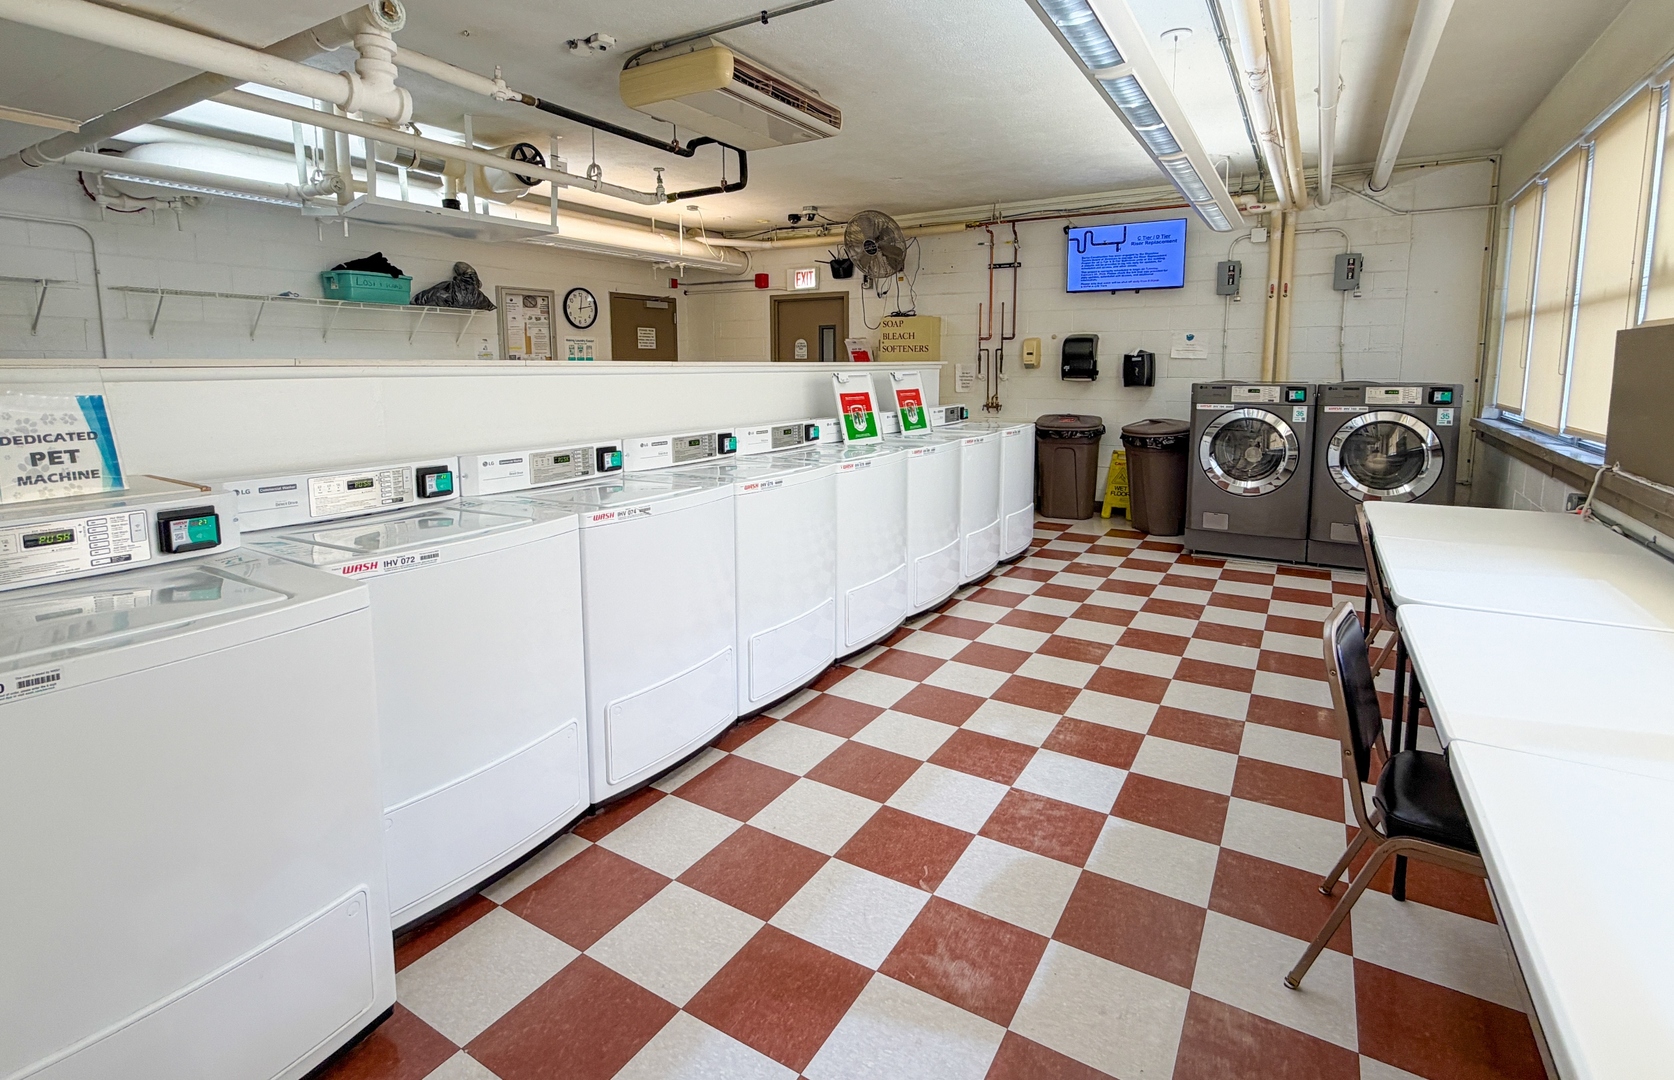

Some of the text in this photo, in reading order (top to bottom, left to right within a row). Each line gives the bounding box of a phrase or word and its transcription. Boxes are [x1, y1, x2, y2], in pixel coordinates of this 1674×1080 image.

[796, 271, 813, 286] EXIT
[882, 332, 915, 340] BLEACH
[882, 345, 929, 353] SOFTENERS
[0, 431, 98, 446] DEDICATED
[29, 449, 80, 467] PET
[17, 469, 101, 486] MACHINE
[593, 512, 615, 521] WASH
[39, 533, 71, 544] PUSH
[342, 561, 378, 574] WASH
[384, 559, 398, 567] IHV
[400, 556, 415, 565] 072
